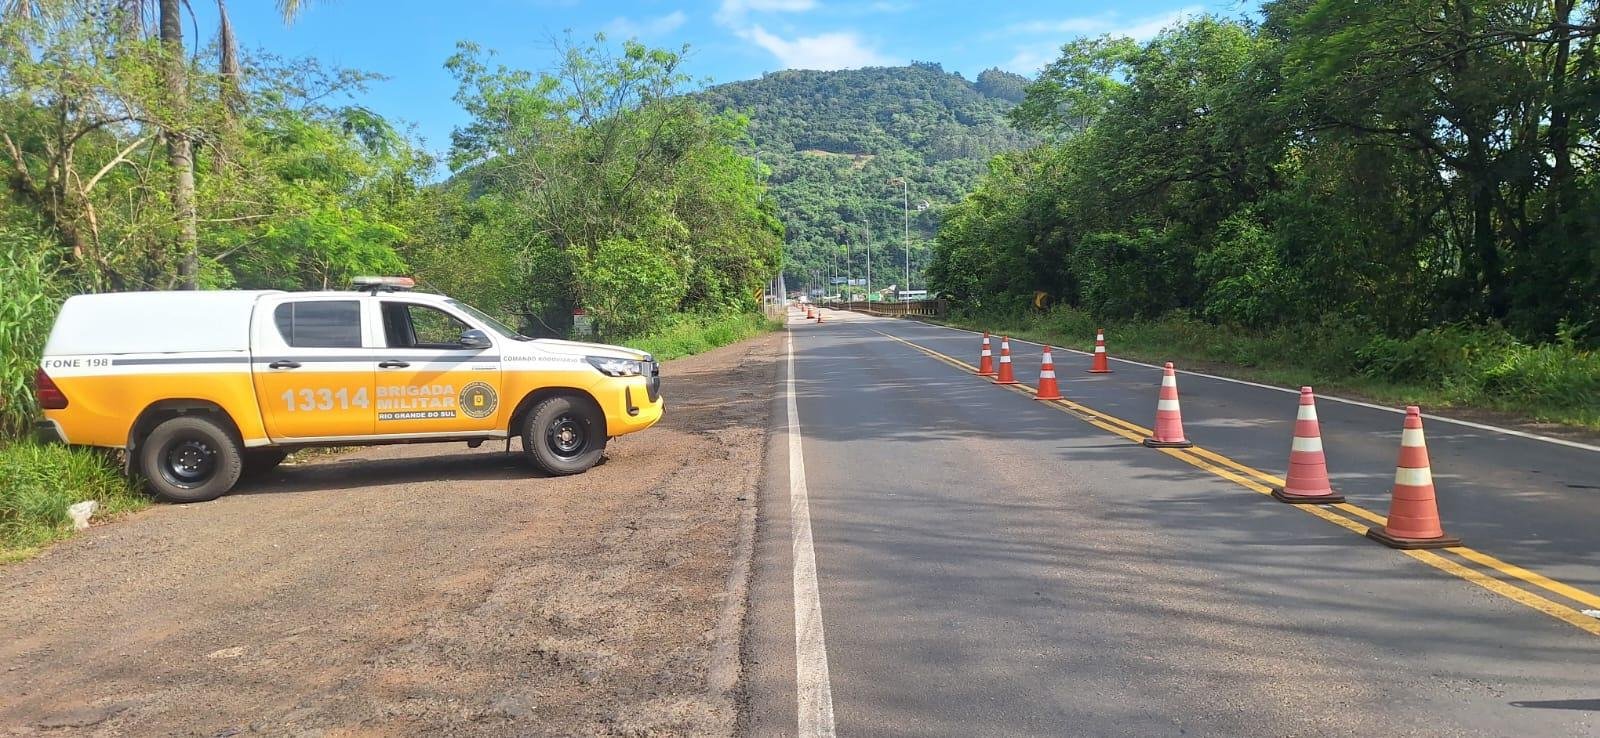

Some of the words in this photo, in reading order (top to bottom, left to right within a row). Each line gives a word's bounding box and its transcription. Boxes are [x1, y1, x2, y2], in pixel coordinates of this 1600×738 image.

[45, 359, 81, 368] FONE
[86, 358, 109, 367] 198
[376, 384, 456, 397] BRIGADA
[281, 386, 369, 412] 13314
[377, 397, 455, 409] MILITAR
[394, 411, 427, 419] GRANDE
